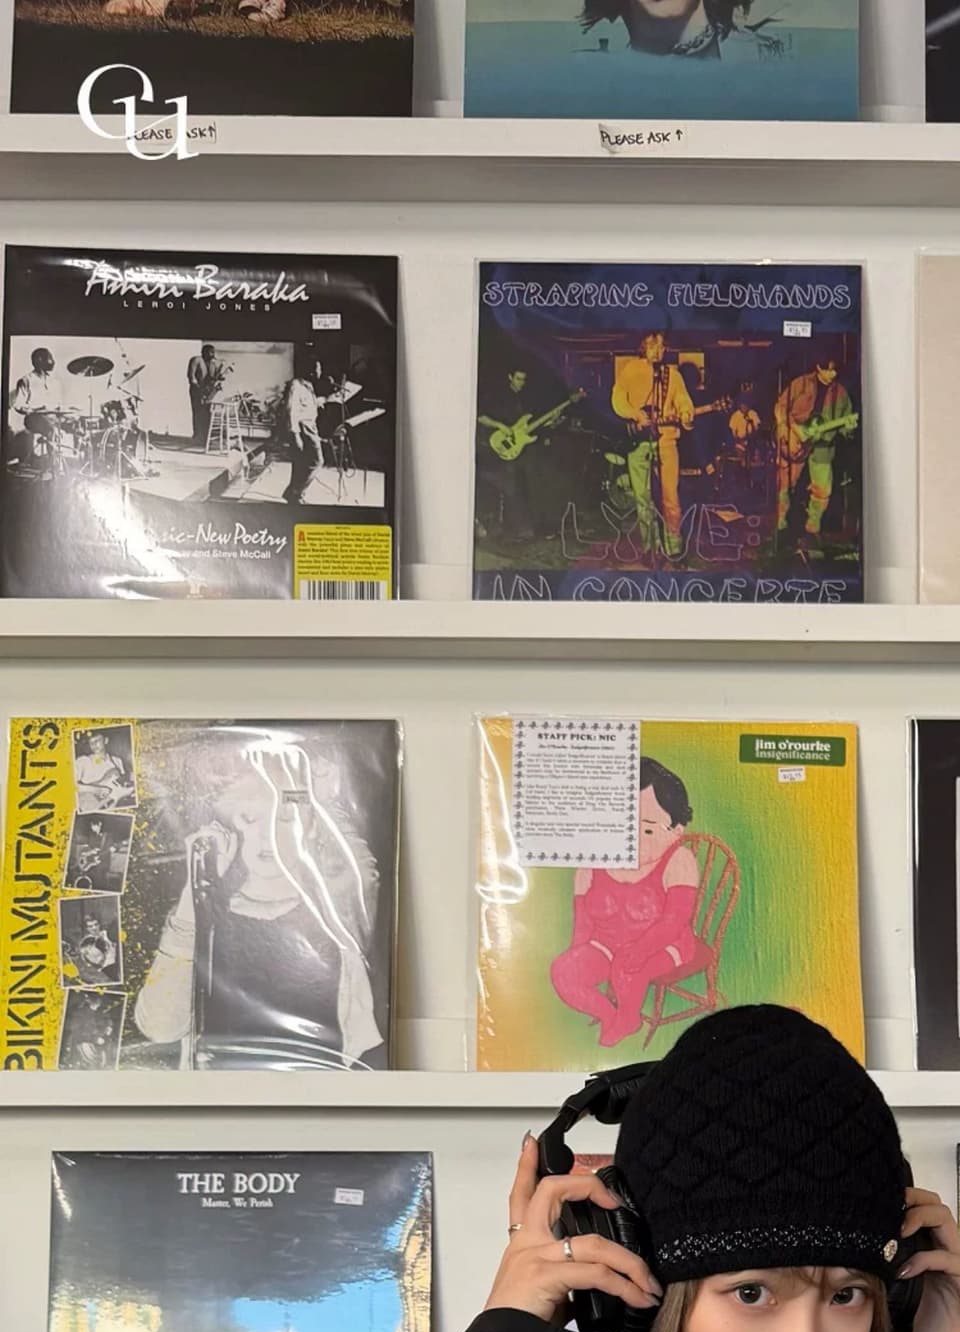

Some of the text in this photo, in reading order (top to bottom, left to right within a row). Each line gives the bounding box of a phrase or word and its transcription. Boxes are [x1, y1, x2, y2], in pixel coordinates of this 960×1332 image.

[127, 128, 173, 141] LEASE
[600, 129, 671, 146] PLEASE ASK
[84, 260, 310, 304] Amiri Baraka
[482, 281, 852, 310] STRAPPING FIELDHANDS
[123, 300, 272, 312] LEROI JONES
[234, 522, 288, 553] Poetry
[239, 550, 271, 560] McCall
[537, 732, 617, 742] STAFF PICK: NIC
[755, 738, 777, 752] jim
[755, 749, 831, 761] insignificance
[3, 720, 62, 1071] BIKINI MUTANTS
[177, 1172, 301, 1194] THE BODY
[233, 1197, 248, 1208] We
